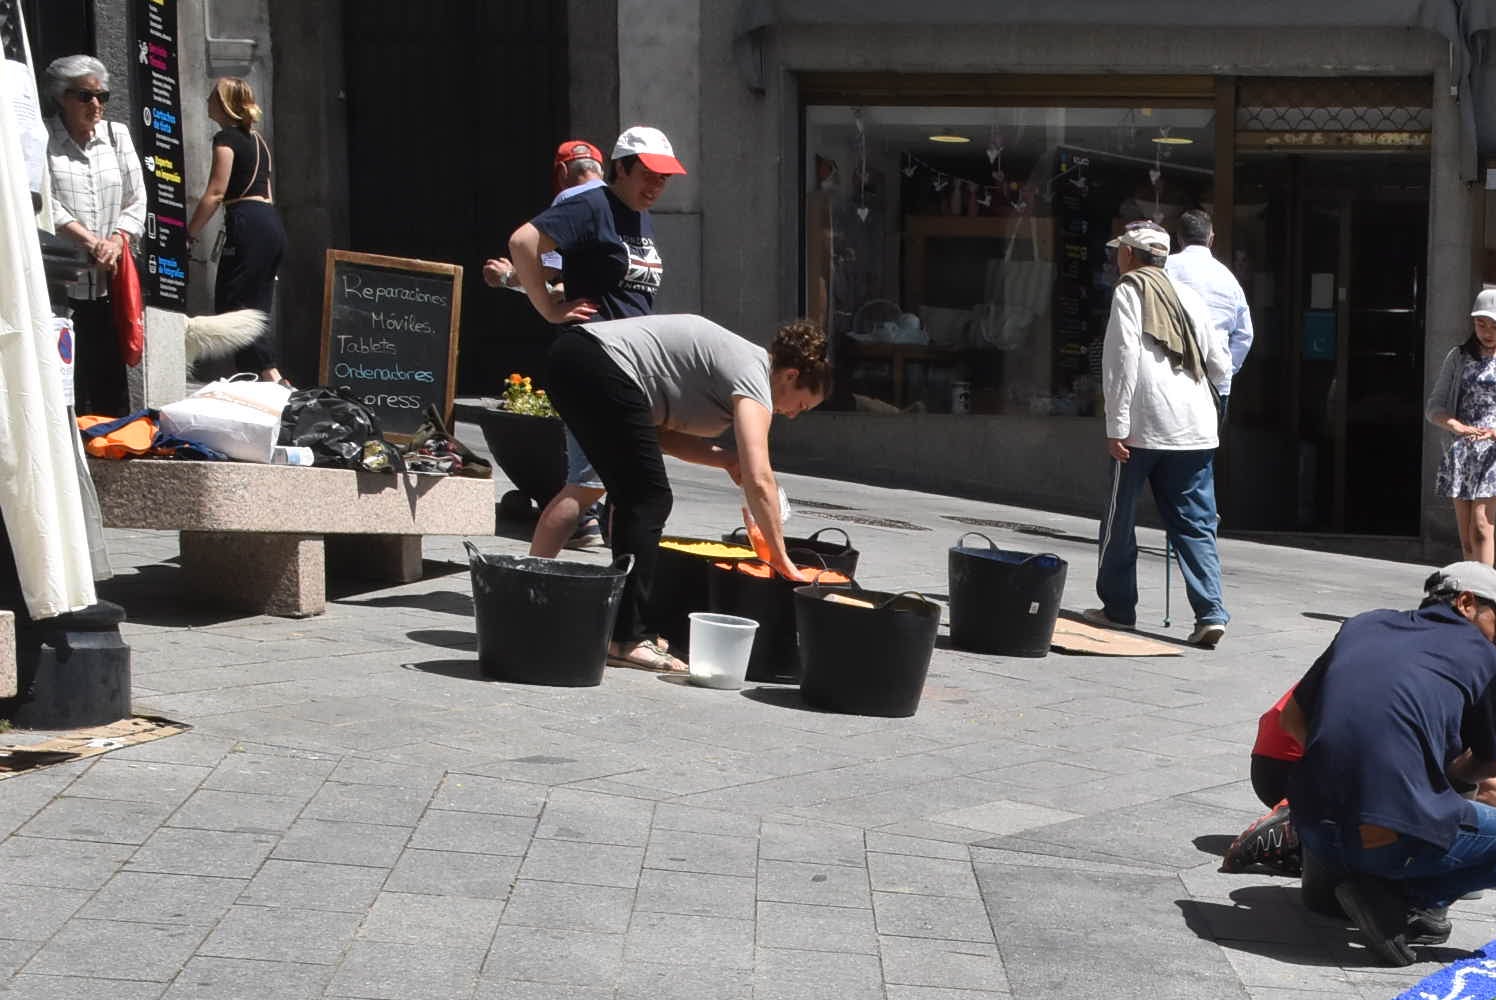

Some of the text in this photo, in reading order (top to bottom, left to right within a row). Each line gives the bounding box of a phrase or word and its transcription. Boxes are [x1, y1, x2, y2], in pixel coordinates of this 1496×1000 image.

[341, 273, 449, 306] Reparaciones
[336, 335, 397, 356] Tablets
[334, 362, 435, 384] Ordenadores
